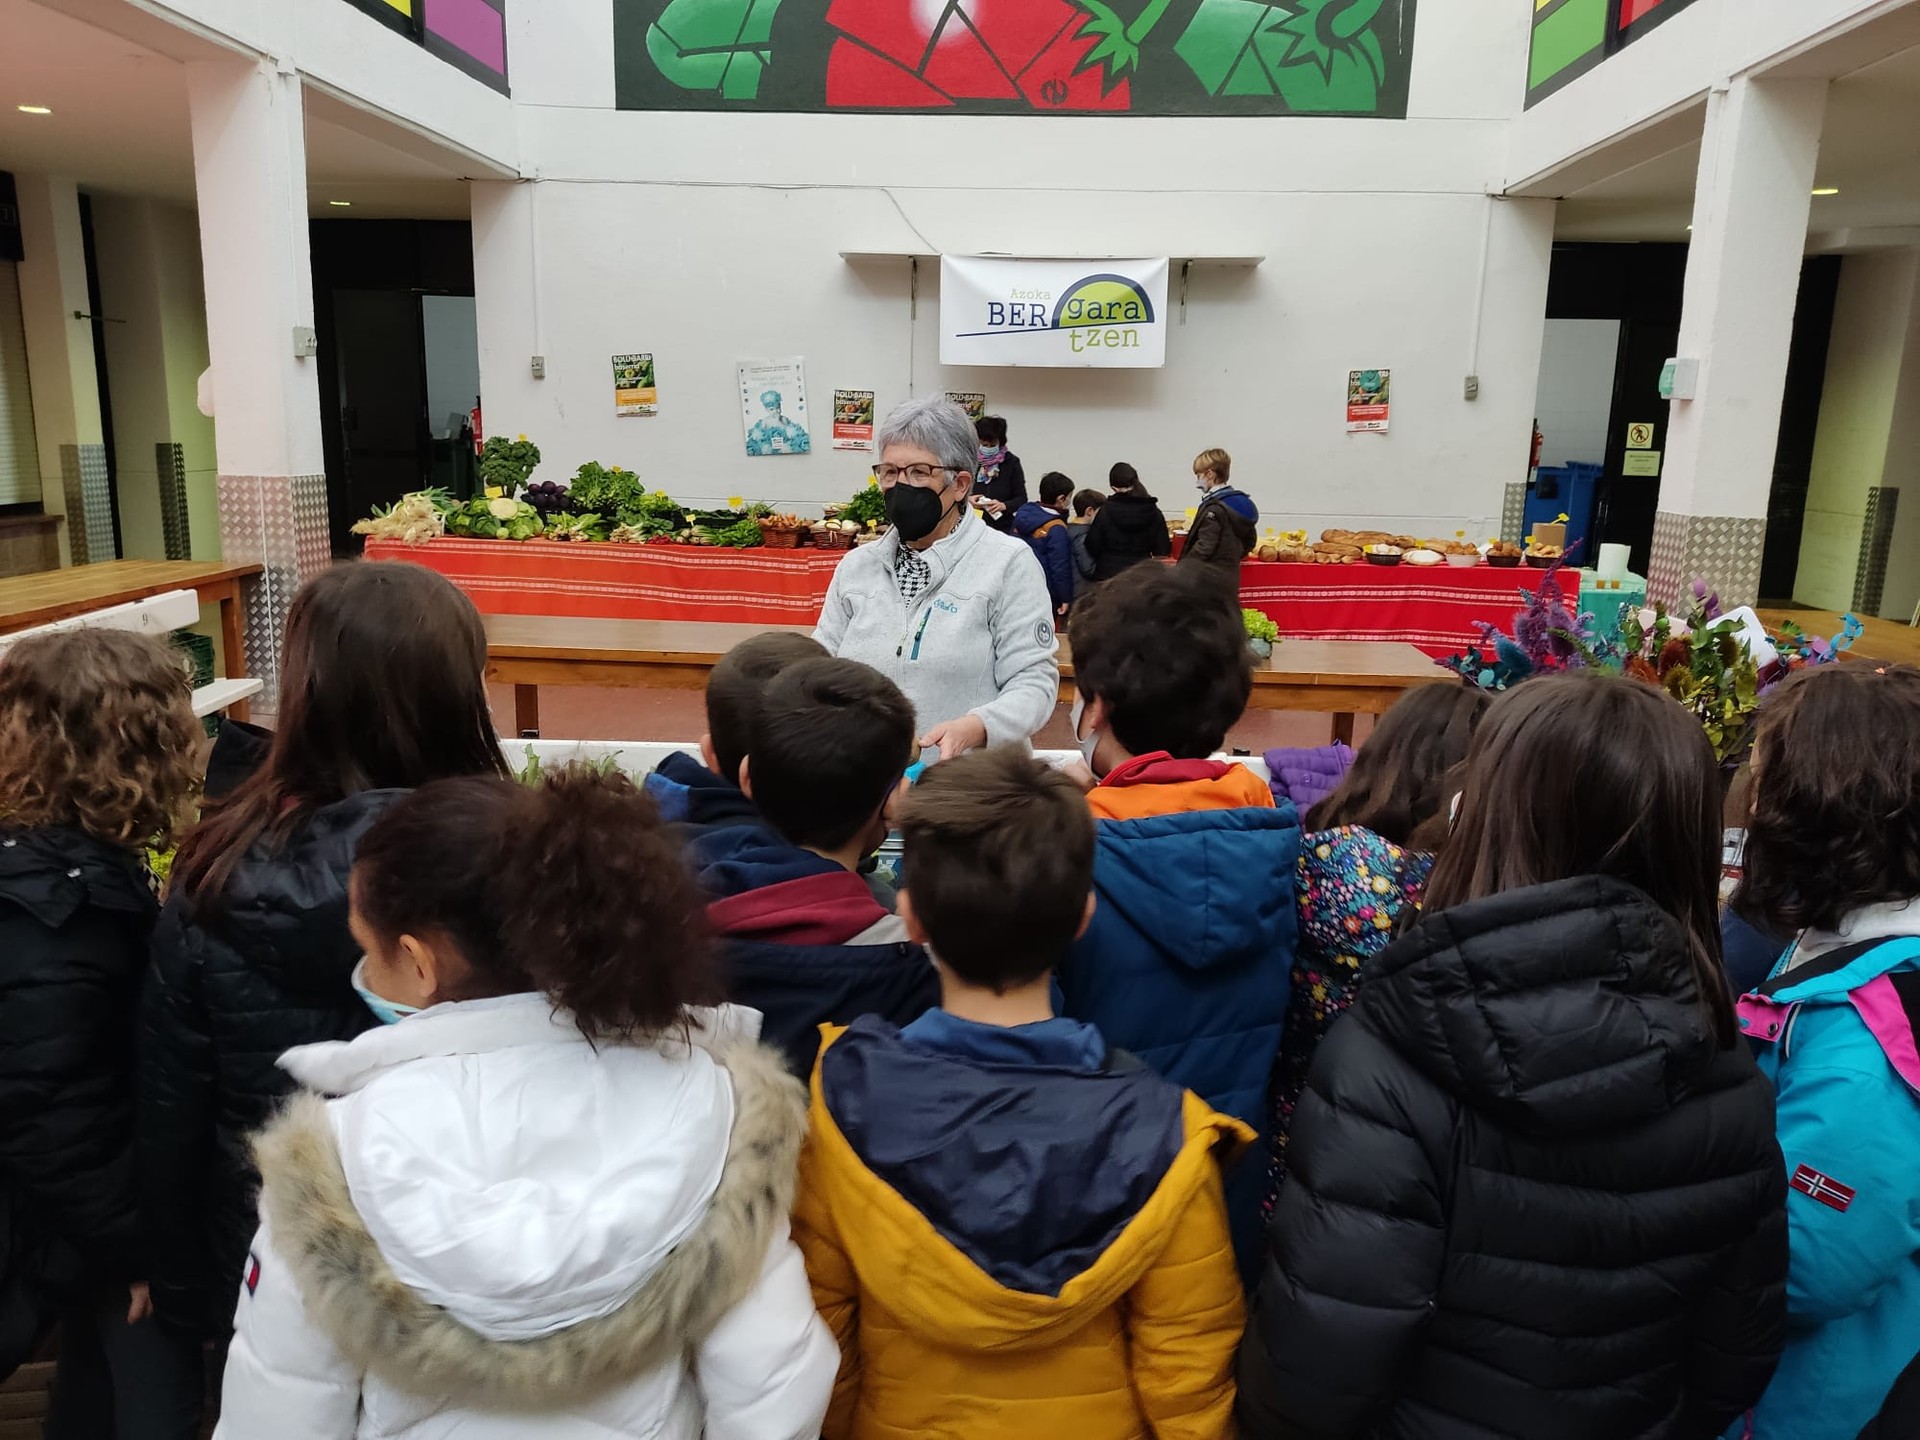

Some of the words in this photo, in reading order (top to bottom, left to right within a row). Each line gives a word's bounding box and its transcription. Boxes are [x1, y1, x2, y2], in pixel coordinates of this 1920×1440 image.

[1010, 289, 1051, 300] Azoka
[987, 302, 1048, 326] BER
[1067, 298, 1140, 320] gara
[1069, 329, 1139, 352] tzen
